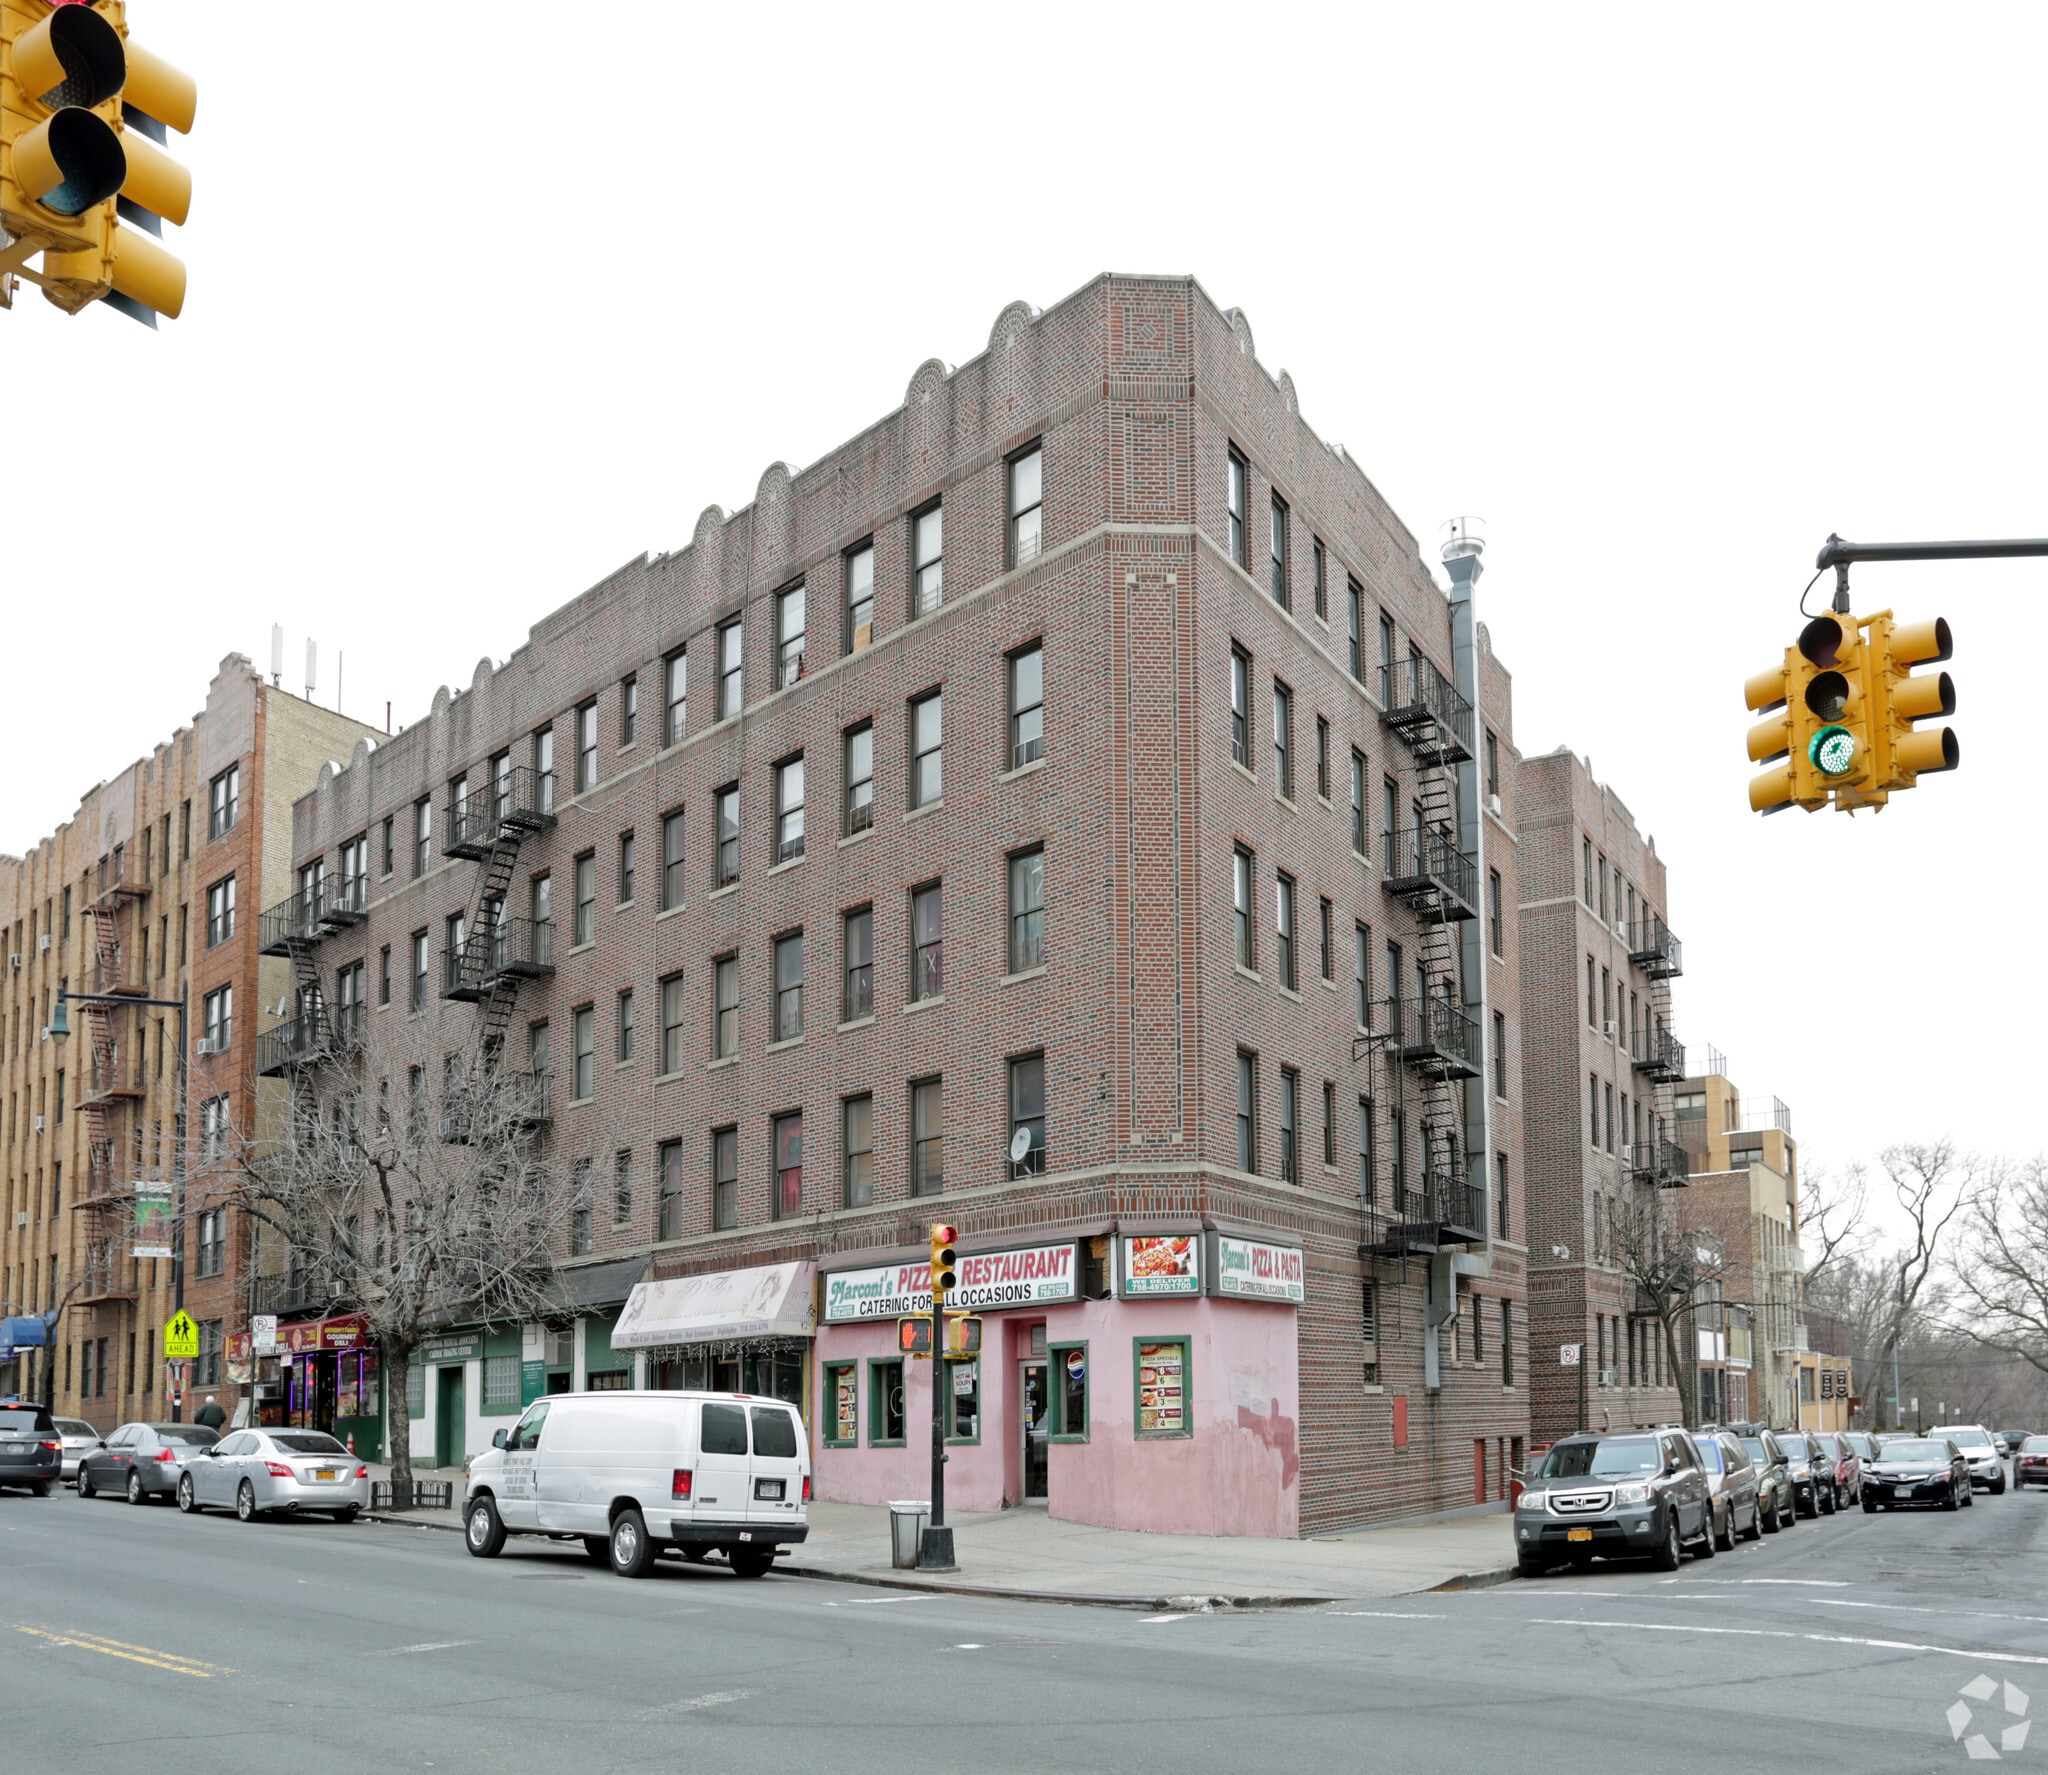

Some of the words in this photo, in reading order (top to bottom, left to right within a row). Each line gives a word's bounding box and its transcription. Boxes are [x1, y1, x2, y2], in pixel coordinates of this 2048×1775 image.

[1221, 1241, 1250, 1275] Marconi's
[1252, 1247, 1274, 1279] PIZZA
[1274, 1251, 1280, 1280] &
[1281, 1252, 1302, 1283] PASTA
[829, 1269, 893, 1306] Marconi's
[897, 1265, 931, 1294] PIZZ
[961, 1248, 1072, 1286] RESTAURANT
[1131, 1283, 1192, 1291] 798-4970/1700
[1239, 1280, 1256, 1293] CATERING
[1269, 1284, 1287, 1297] OCCASIONS
[859, 1296, 910, 1316] CATERING
[911, 1294, 933, 1311] FOR
[960, 1283, 1032, 1306] OCCASIONS
[326, 1333, 357, 1341] GOURMET
[168, 1345, 195, 1354] AHEAD
[955, 1380, 971, 1388] SOUPS
